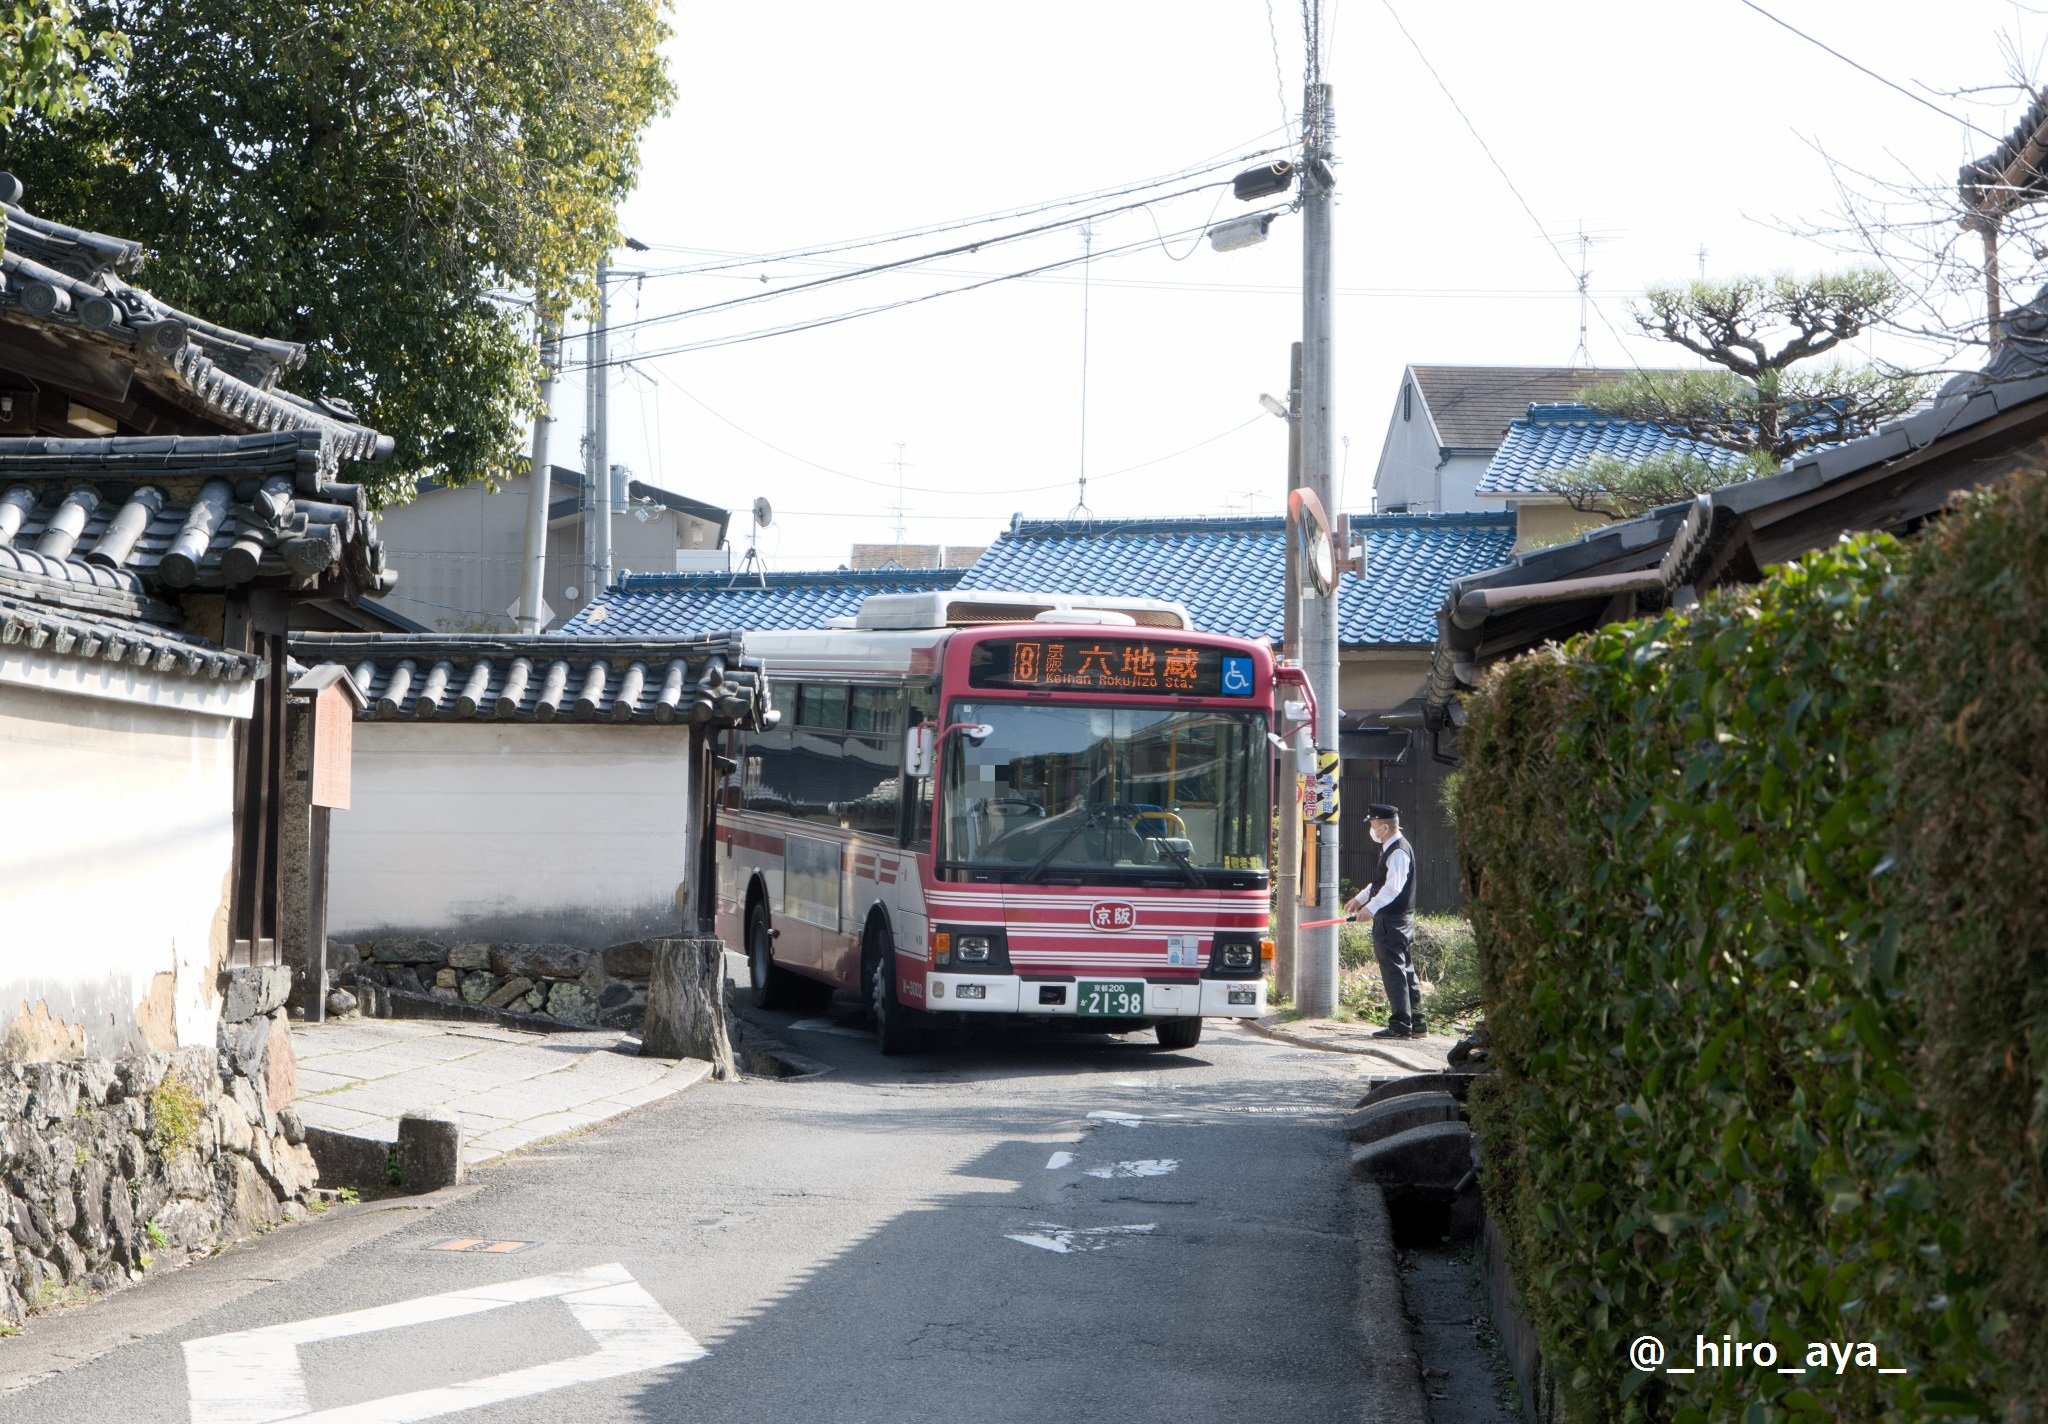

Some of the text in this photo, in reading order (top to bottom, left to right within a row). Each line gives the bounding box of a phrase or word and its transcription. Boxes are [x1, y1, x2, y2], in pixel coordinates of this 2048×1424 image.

[1020, 646, 1034, 678] 8
[1046, 644, 1064, 672] 京阪
[1078, 645, 1200, 678] 六地蔵
[1046, 672, 1194, 689] Keihan Rokujizo Sta.
[1095, 906, 1131, 925] 京阪
[1088, 992, 1141, 1014] 21-98
